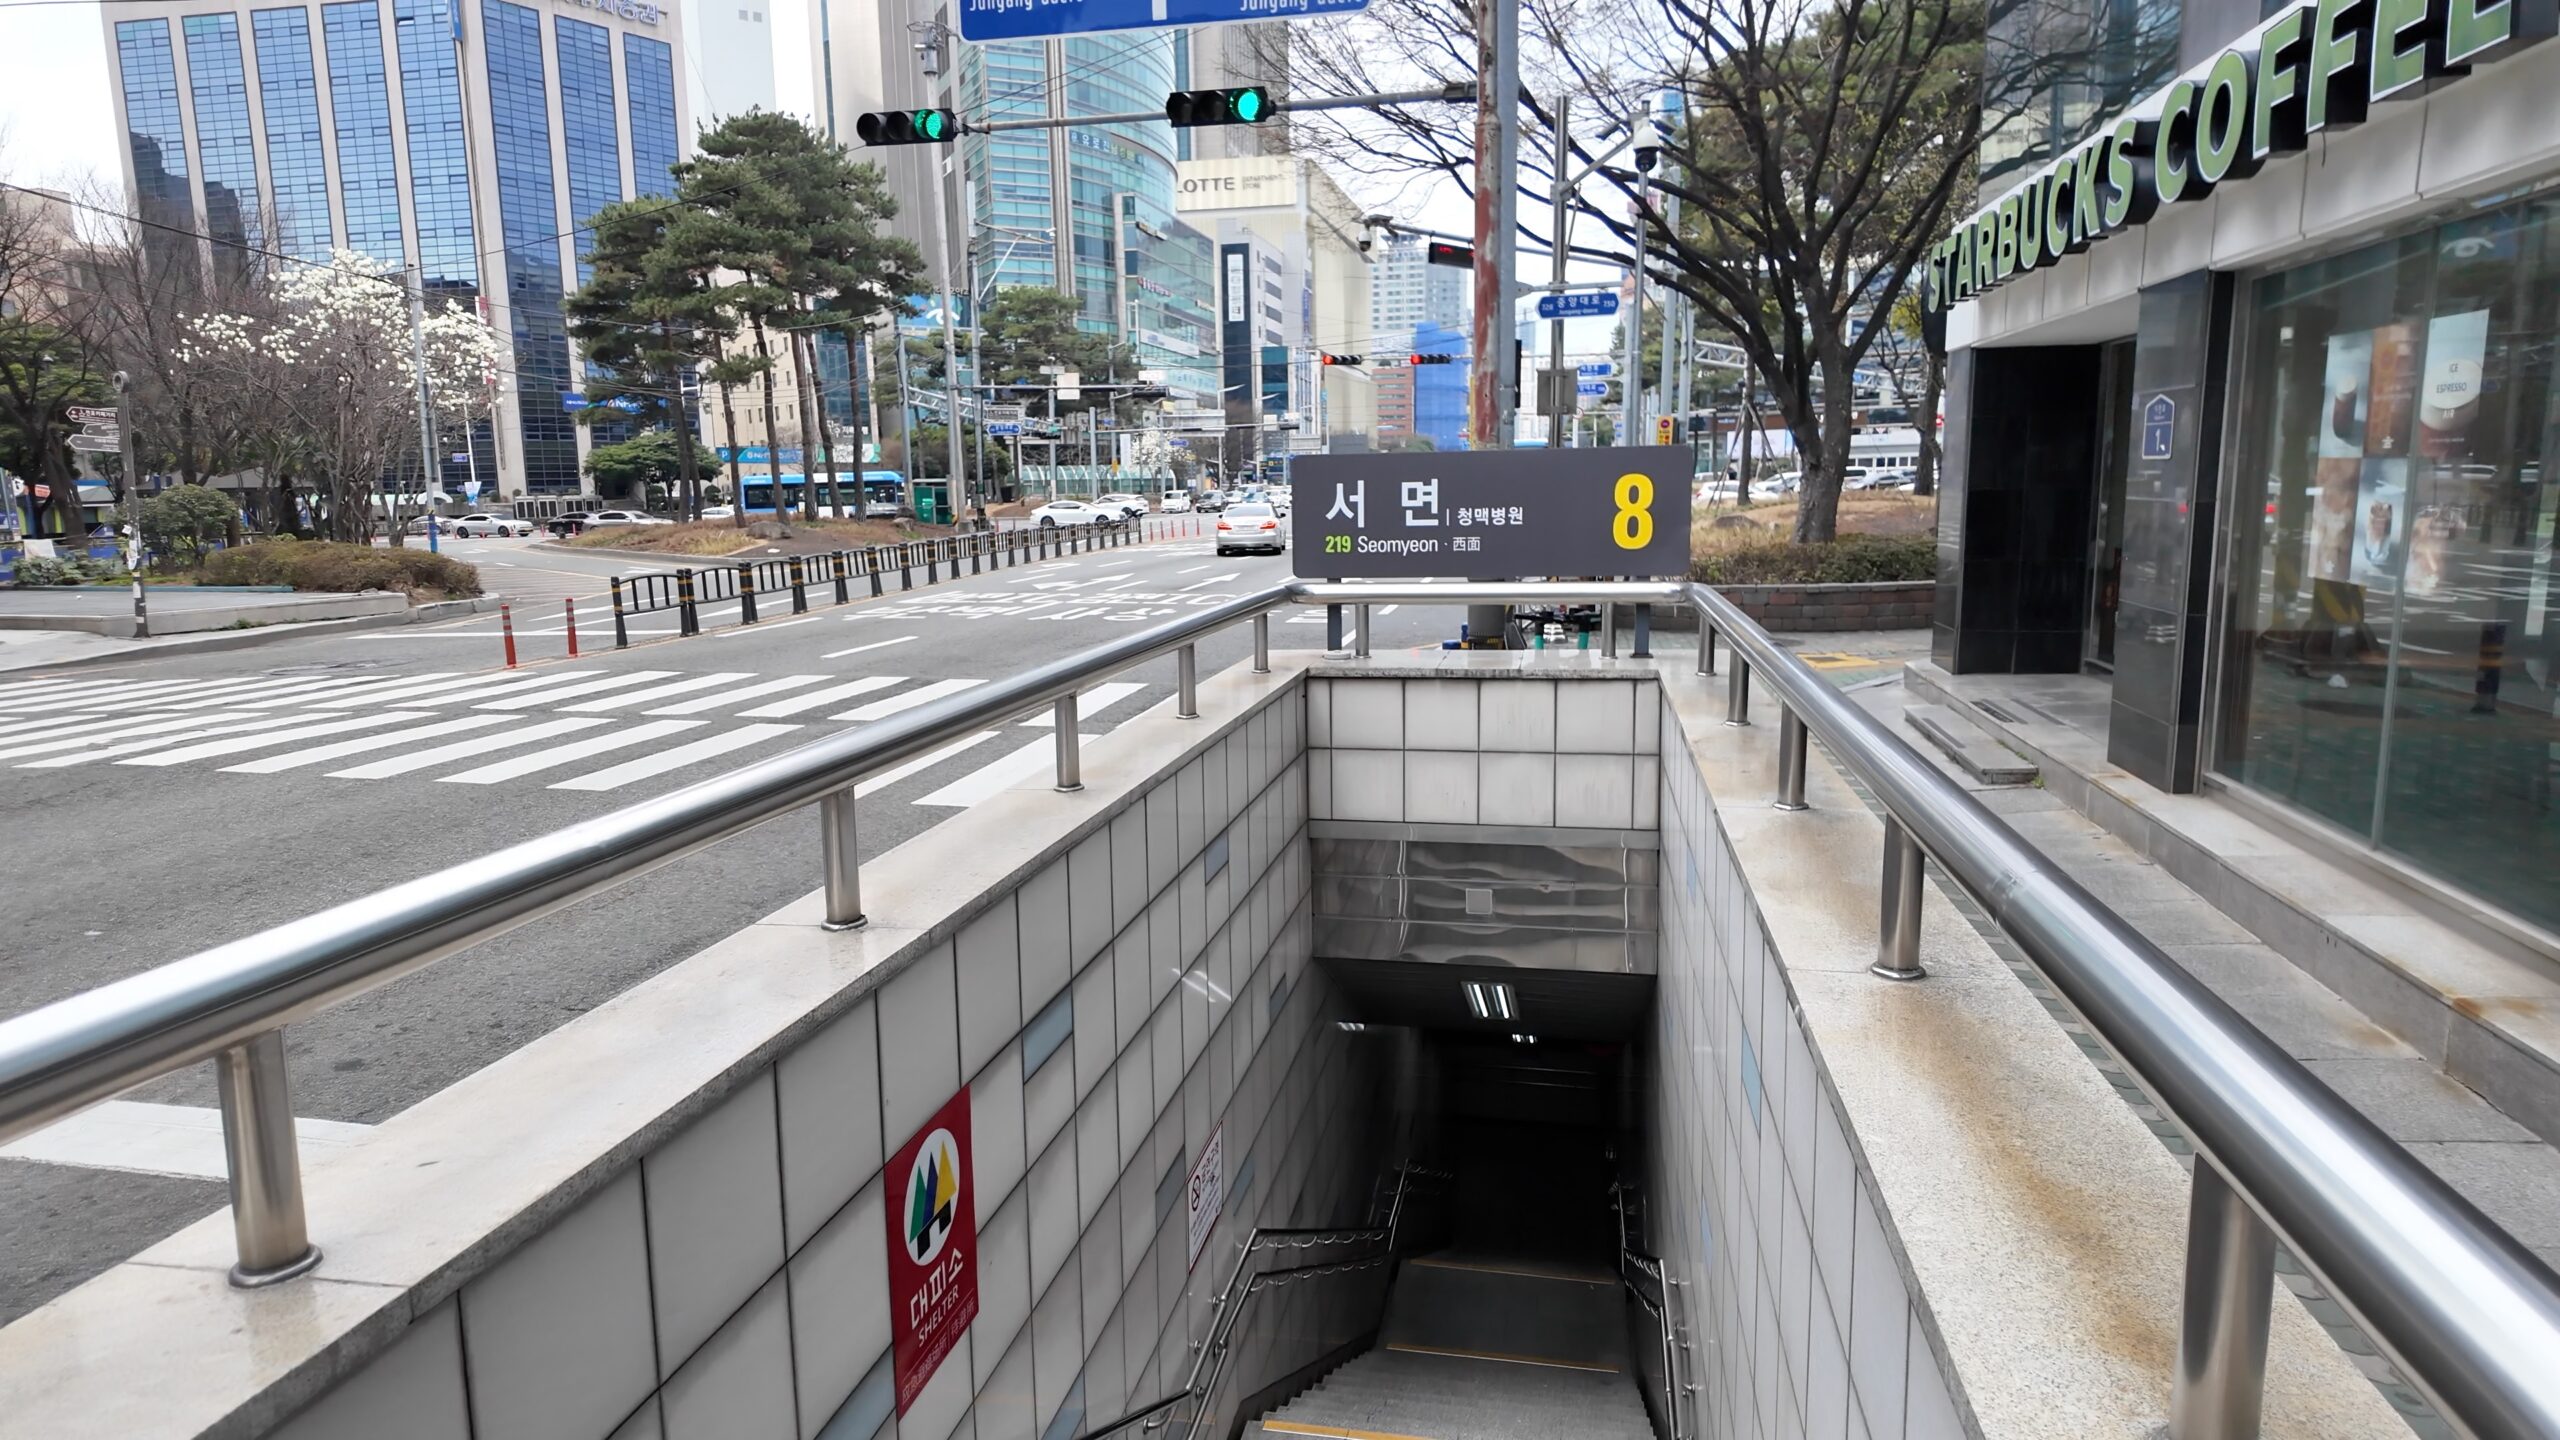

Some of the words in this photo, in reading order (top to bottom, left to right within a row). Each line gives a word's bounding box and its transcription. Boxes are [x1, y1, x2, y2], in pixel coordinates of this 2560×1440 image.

[1928, 117, 2138, 314] STARBUCKS
[1325, 535, 1352, 554] 219
[1357, 534, 1439, 558] Seomyeon
[1452, 536, 1481, 552] 西面
[1456, 506, 1524, 526] 청맥병원
[1612, 472, 1655, 551] 8
[910, 1247, 964, 1330] 대피소
[918, 1284, 959, 1348] SHELTER
